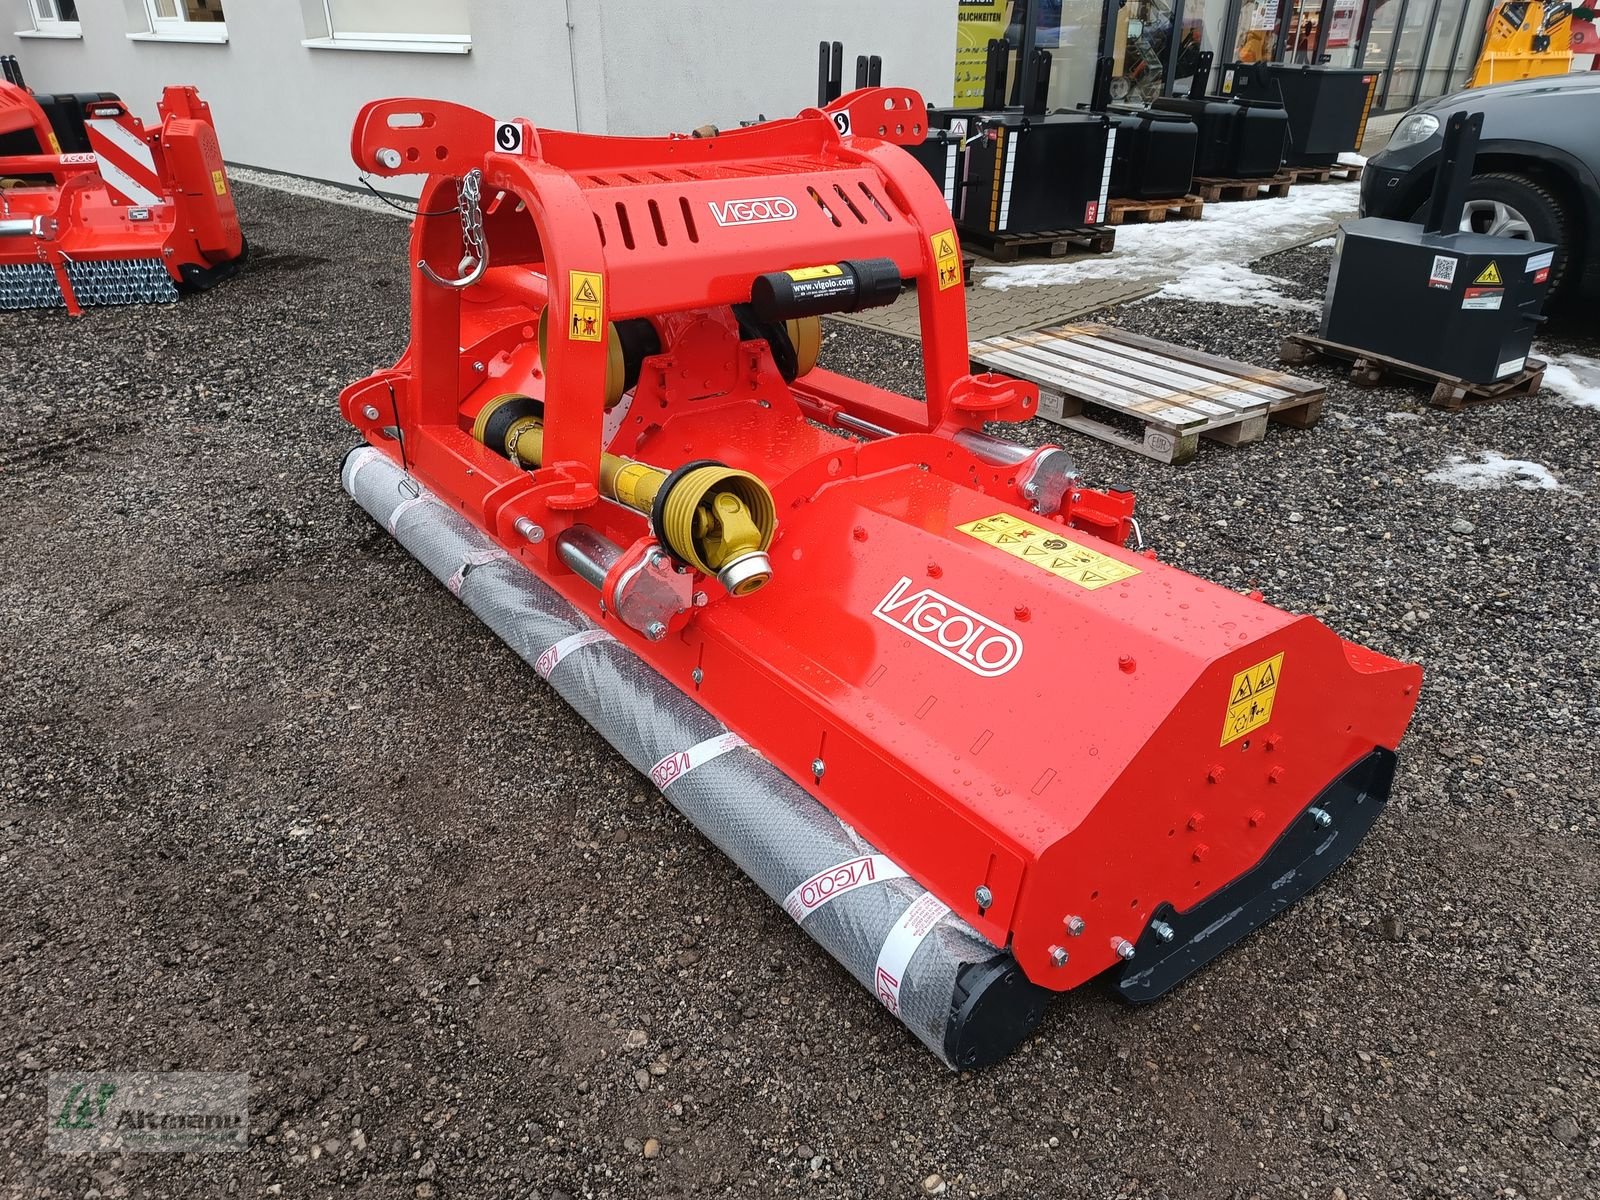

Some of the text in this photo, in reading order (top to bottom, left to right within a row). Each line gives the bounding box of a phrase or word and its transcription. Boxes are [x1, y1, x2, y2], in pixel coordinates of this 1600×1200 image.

[708, 196, 798, 227] VIGOLO
[793, 278, 853, 292] www.vigolo.com
[871, 575, 1024, 678] VIGOLO
[799, 857, 876, 908] VIGOLO
